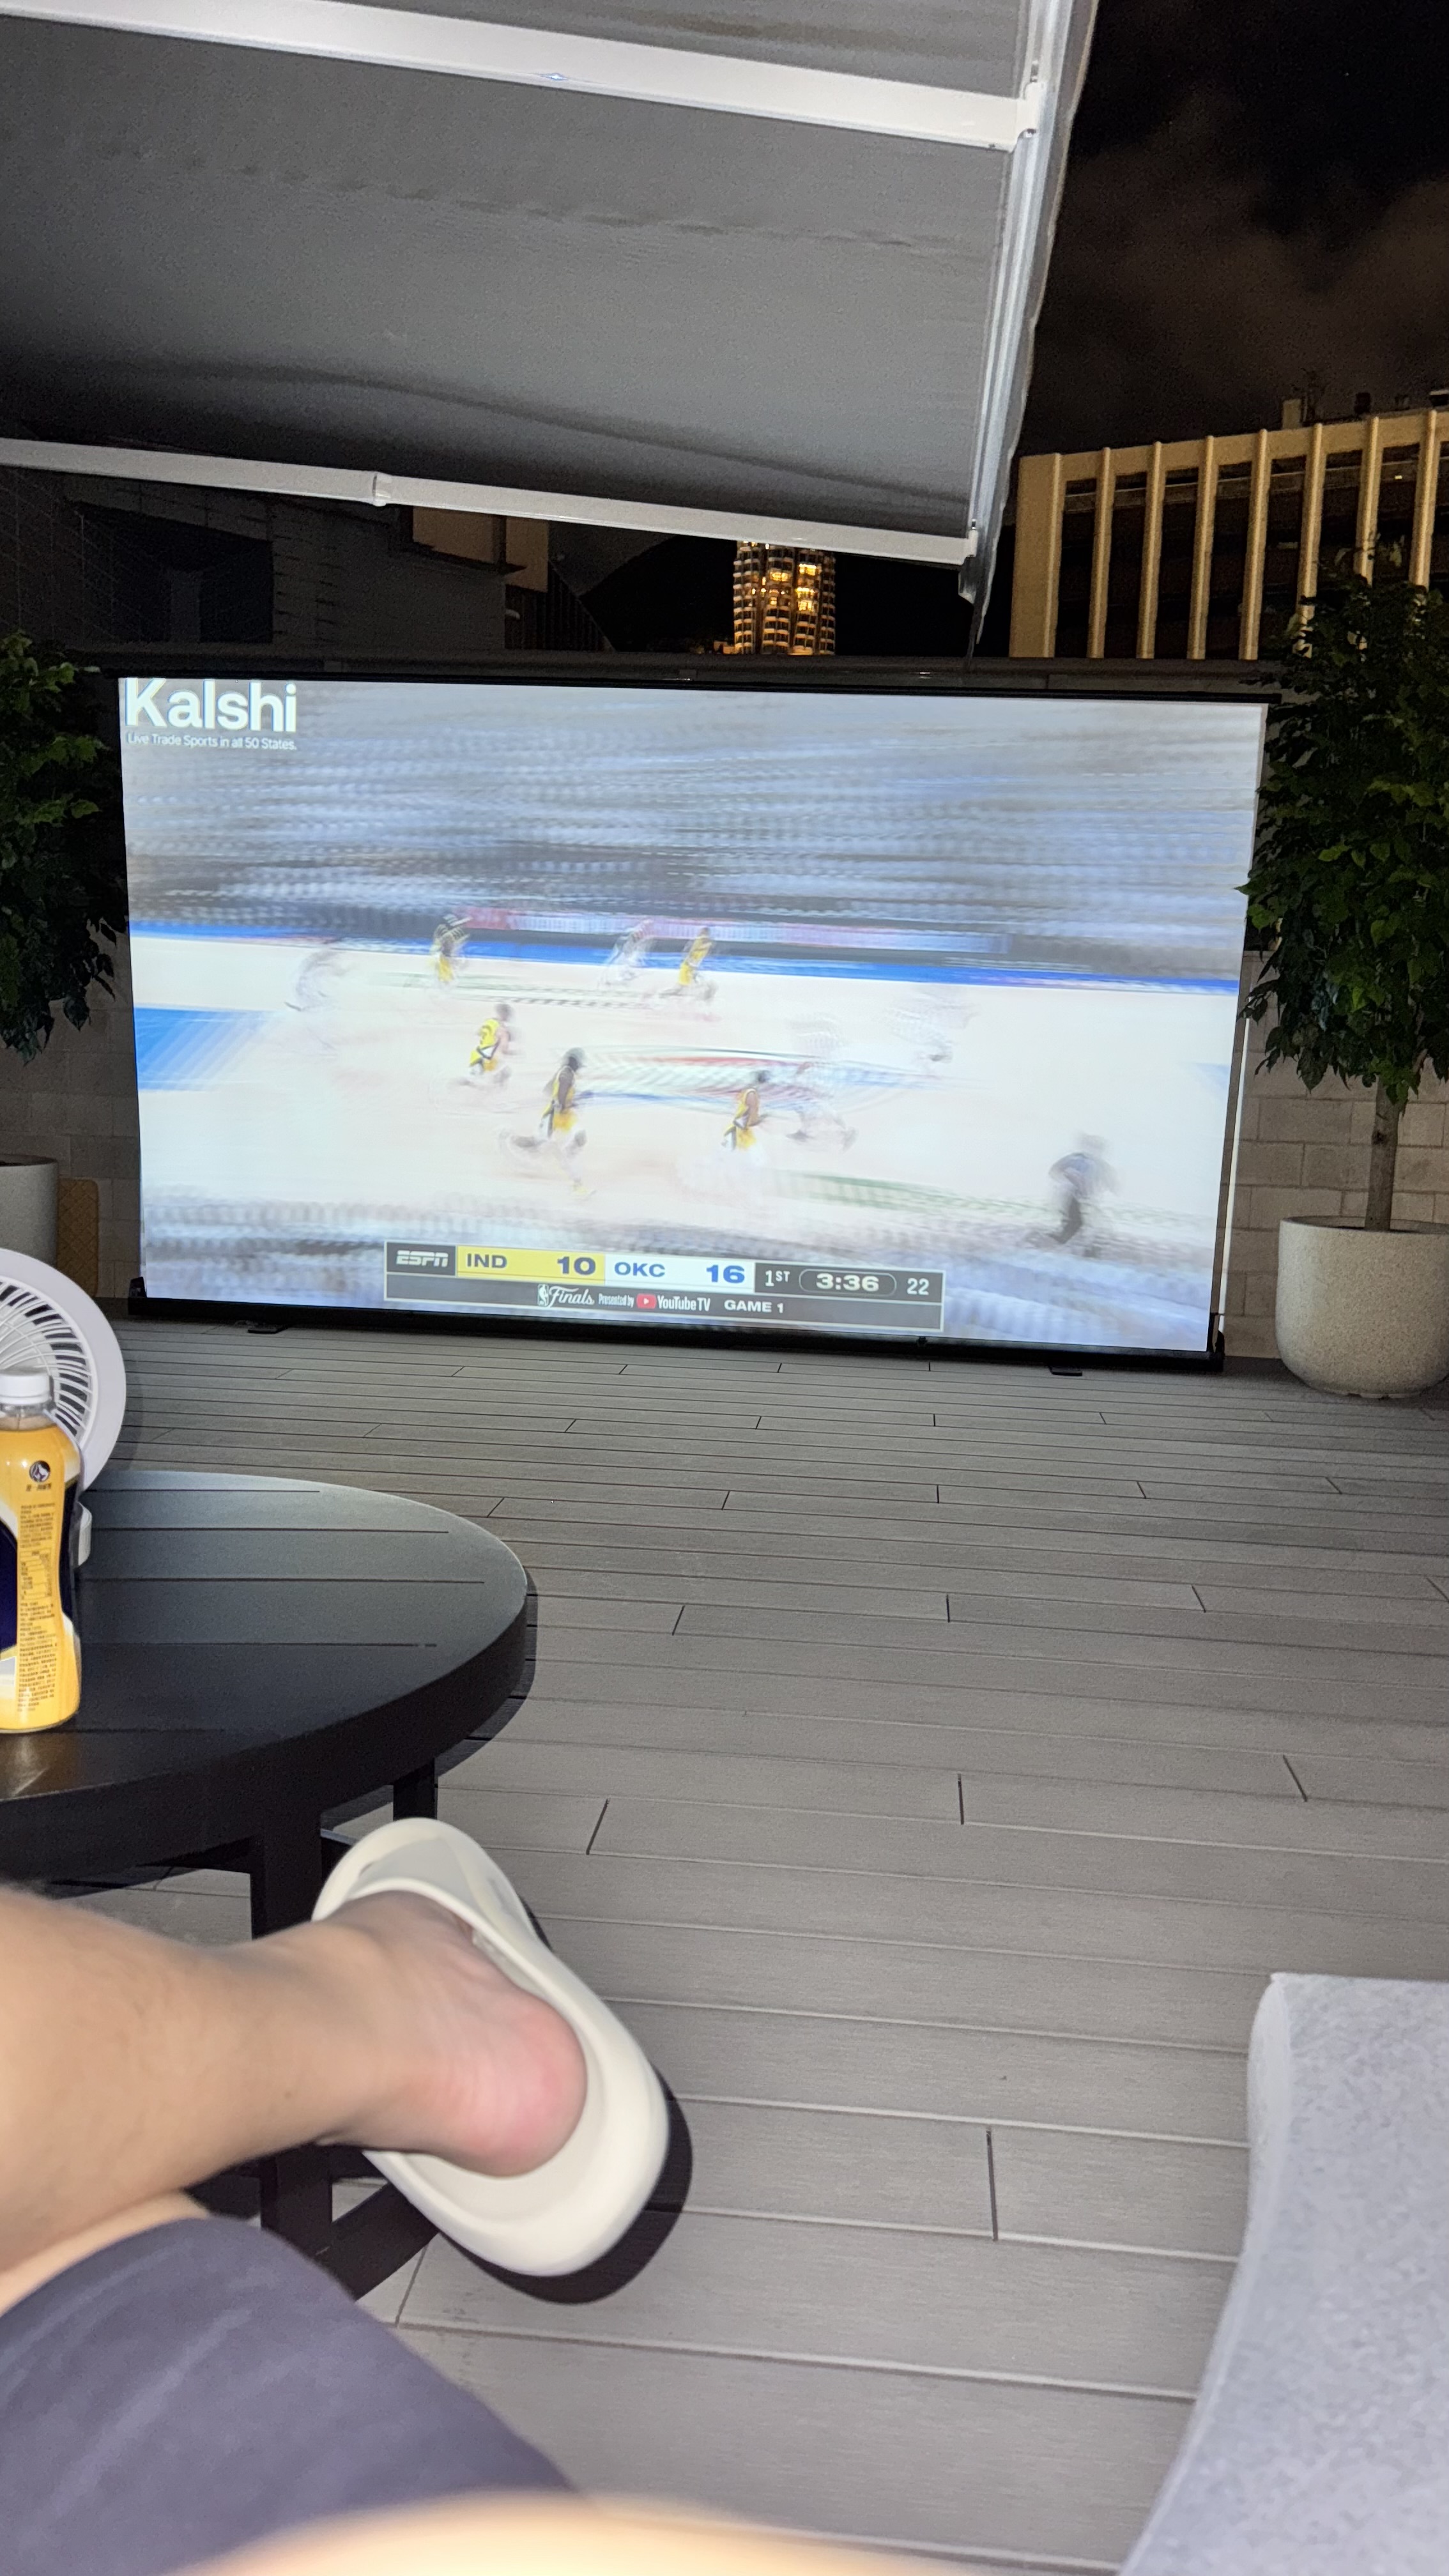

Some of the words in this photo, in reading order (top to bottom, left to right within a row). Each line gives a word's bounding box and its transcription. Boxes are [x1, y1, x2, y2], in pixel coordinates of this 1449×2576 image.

[125, 677, 296, 733] Kalshi
[126, 733, 149, 745] Live
[152, 733, 181, 746] Trade
[183, 735, 217, 748] Sports
[220, 736, 229, 747] in
[231, 737, 243, 748] all
[245, 737, 259, 749] 50
[261, 738, 296, 751] States.
[396, 1250, 448, 1268] ESPN
[467, 1254, 507, 1269] IND
[557, 1256, 597, 1275] 10
[614, 1261, 666, 1278] OKC
[706, 1264, 746, 1284] 16
[765, 1270, 790, 1287] 1ST
[816, 1273, 880, 1292] 3:36
[907, 1278, 930, 1296] 22
[549, 1285, 595, 1308] Finals
[598, 1293, 626, 1307] Presented
[627, 1294, 635, 1308] by
[657, 1294, 696, 1310] YouTube
[697, 1297, 711, 1312] TV
[724, 1300, 772, 1313] GAME
[777, 1303, 784, 1314] 1
